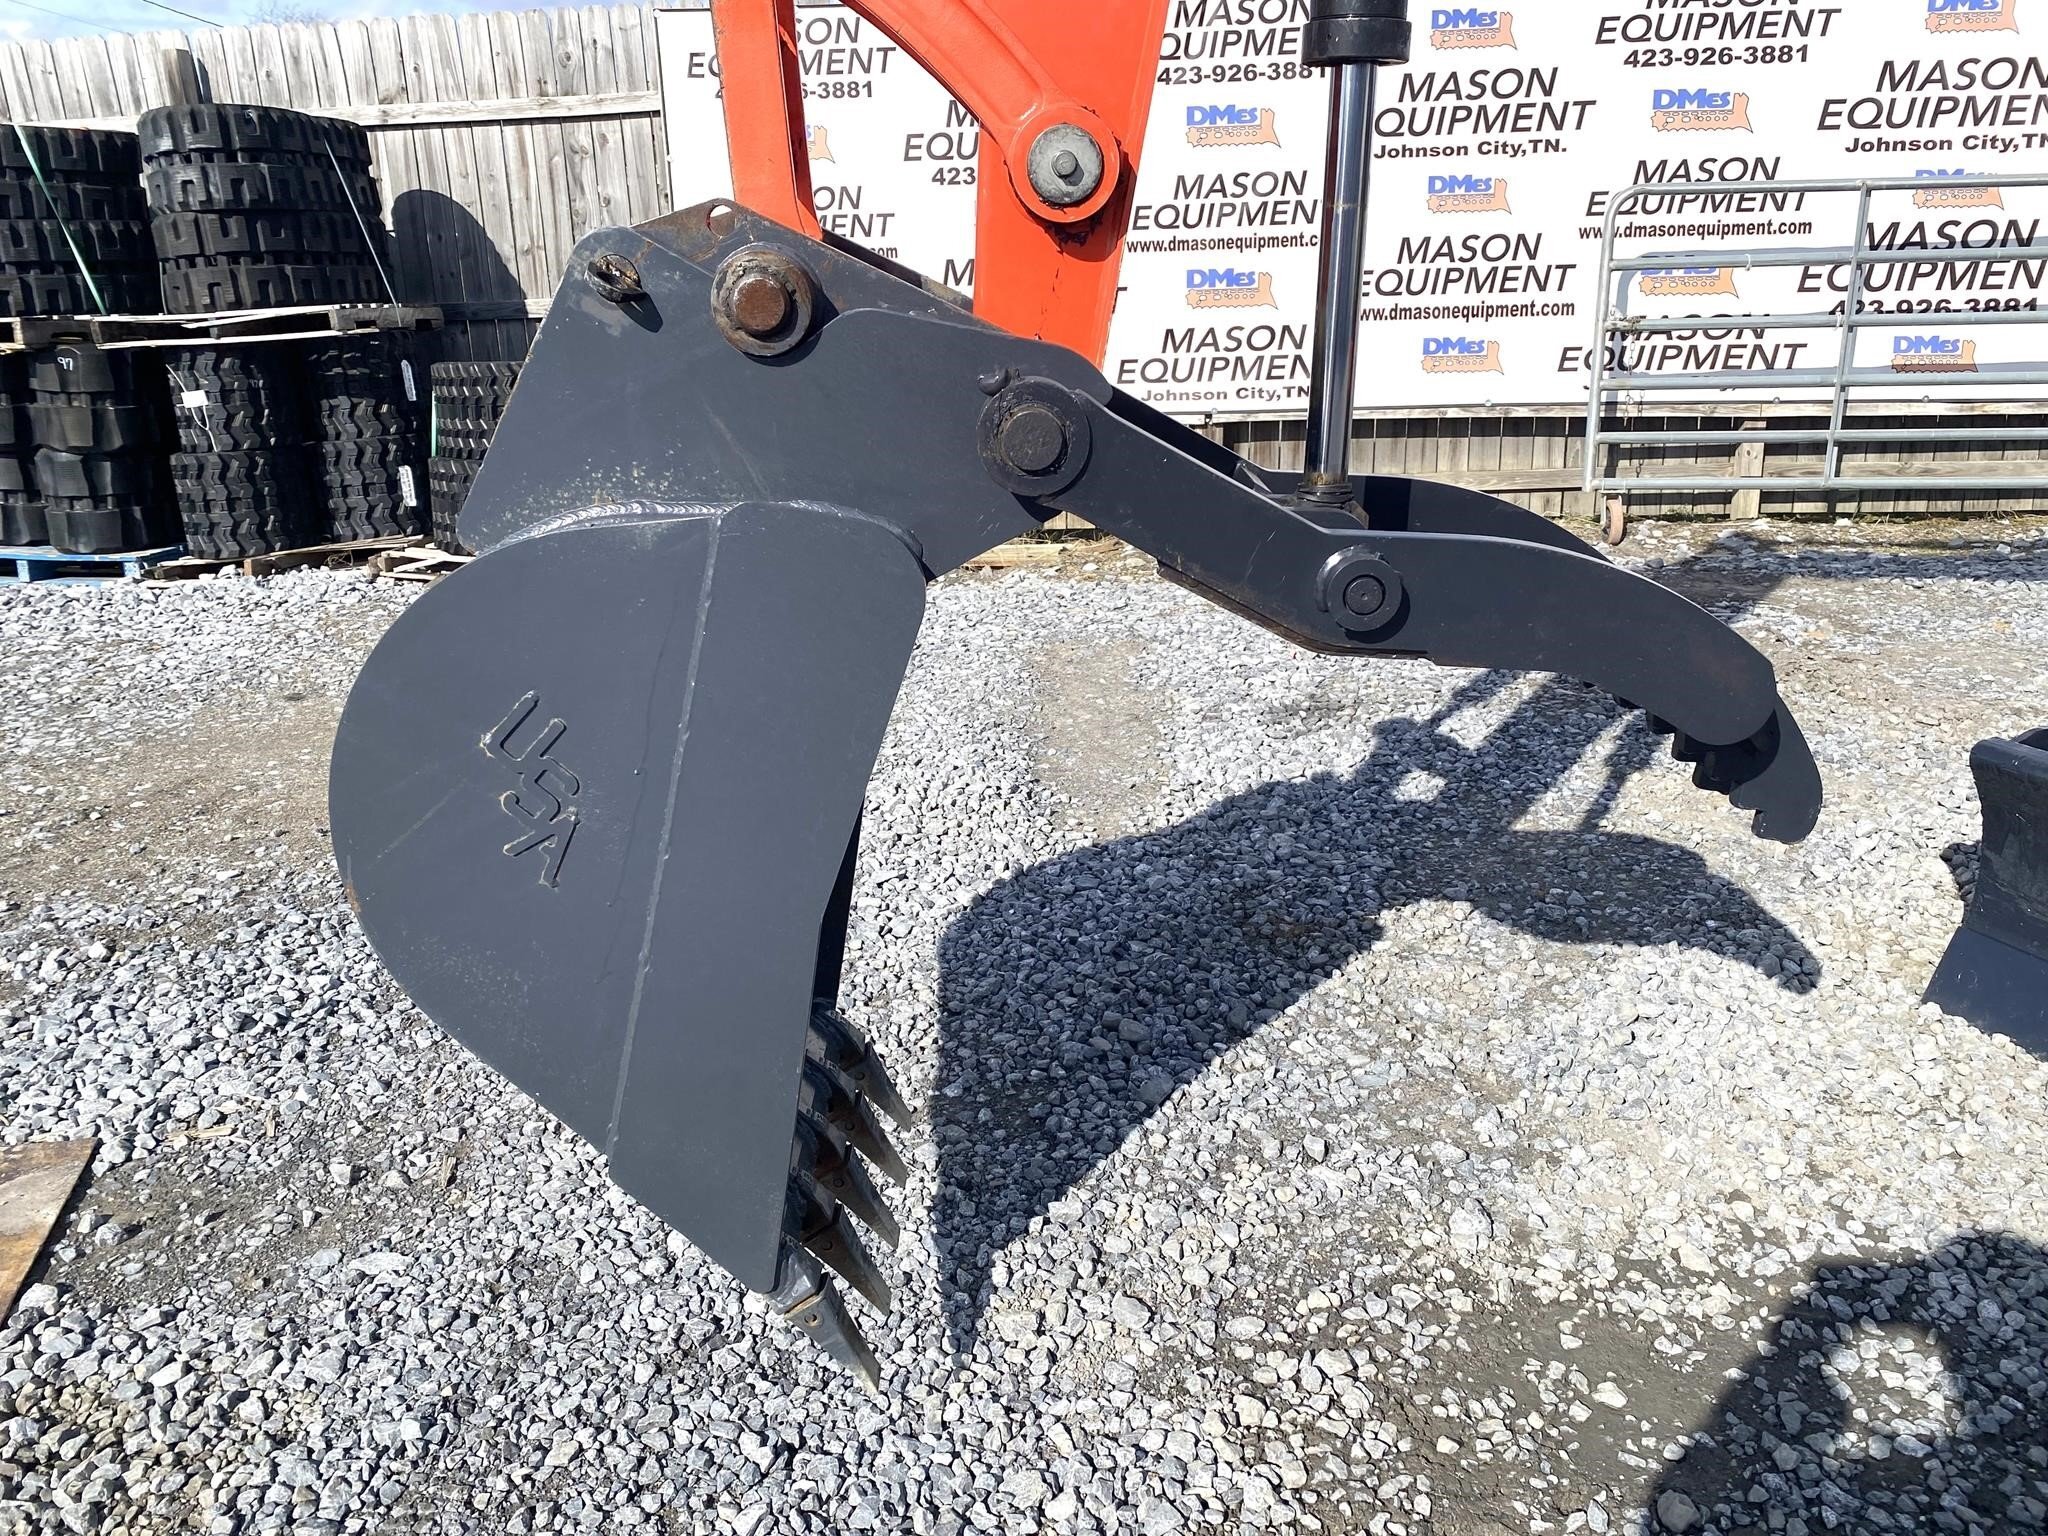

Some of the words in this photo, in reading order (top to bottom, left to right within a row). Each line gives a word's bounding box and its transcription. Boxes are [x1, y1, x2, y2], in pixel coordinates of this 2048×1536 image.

[1595, 8, 1841, 44] EQUIPMENT
[1624, 44, 1808, 68] 423-926-3881
[1398, 67, 1558, 102] MASON
[1374, 144, 1468, 159] Johnson
[1845, 137, 1952, 152] Johnson
[1173, 170, 1308, 200] MASON
[1632, 157, 1780, 185] MASON
[1132, 199, 1322, 230] EQUIPMEN
[1397, 233, 1542, 264] MASON
[1161, 324, 1307, 354] MASON
[57, 356, 73, 371] 97
[1557, 343, 1808, 373] EQUIPMENT
[1141, 389, 1228, 402] Johnson
